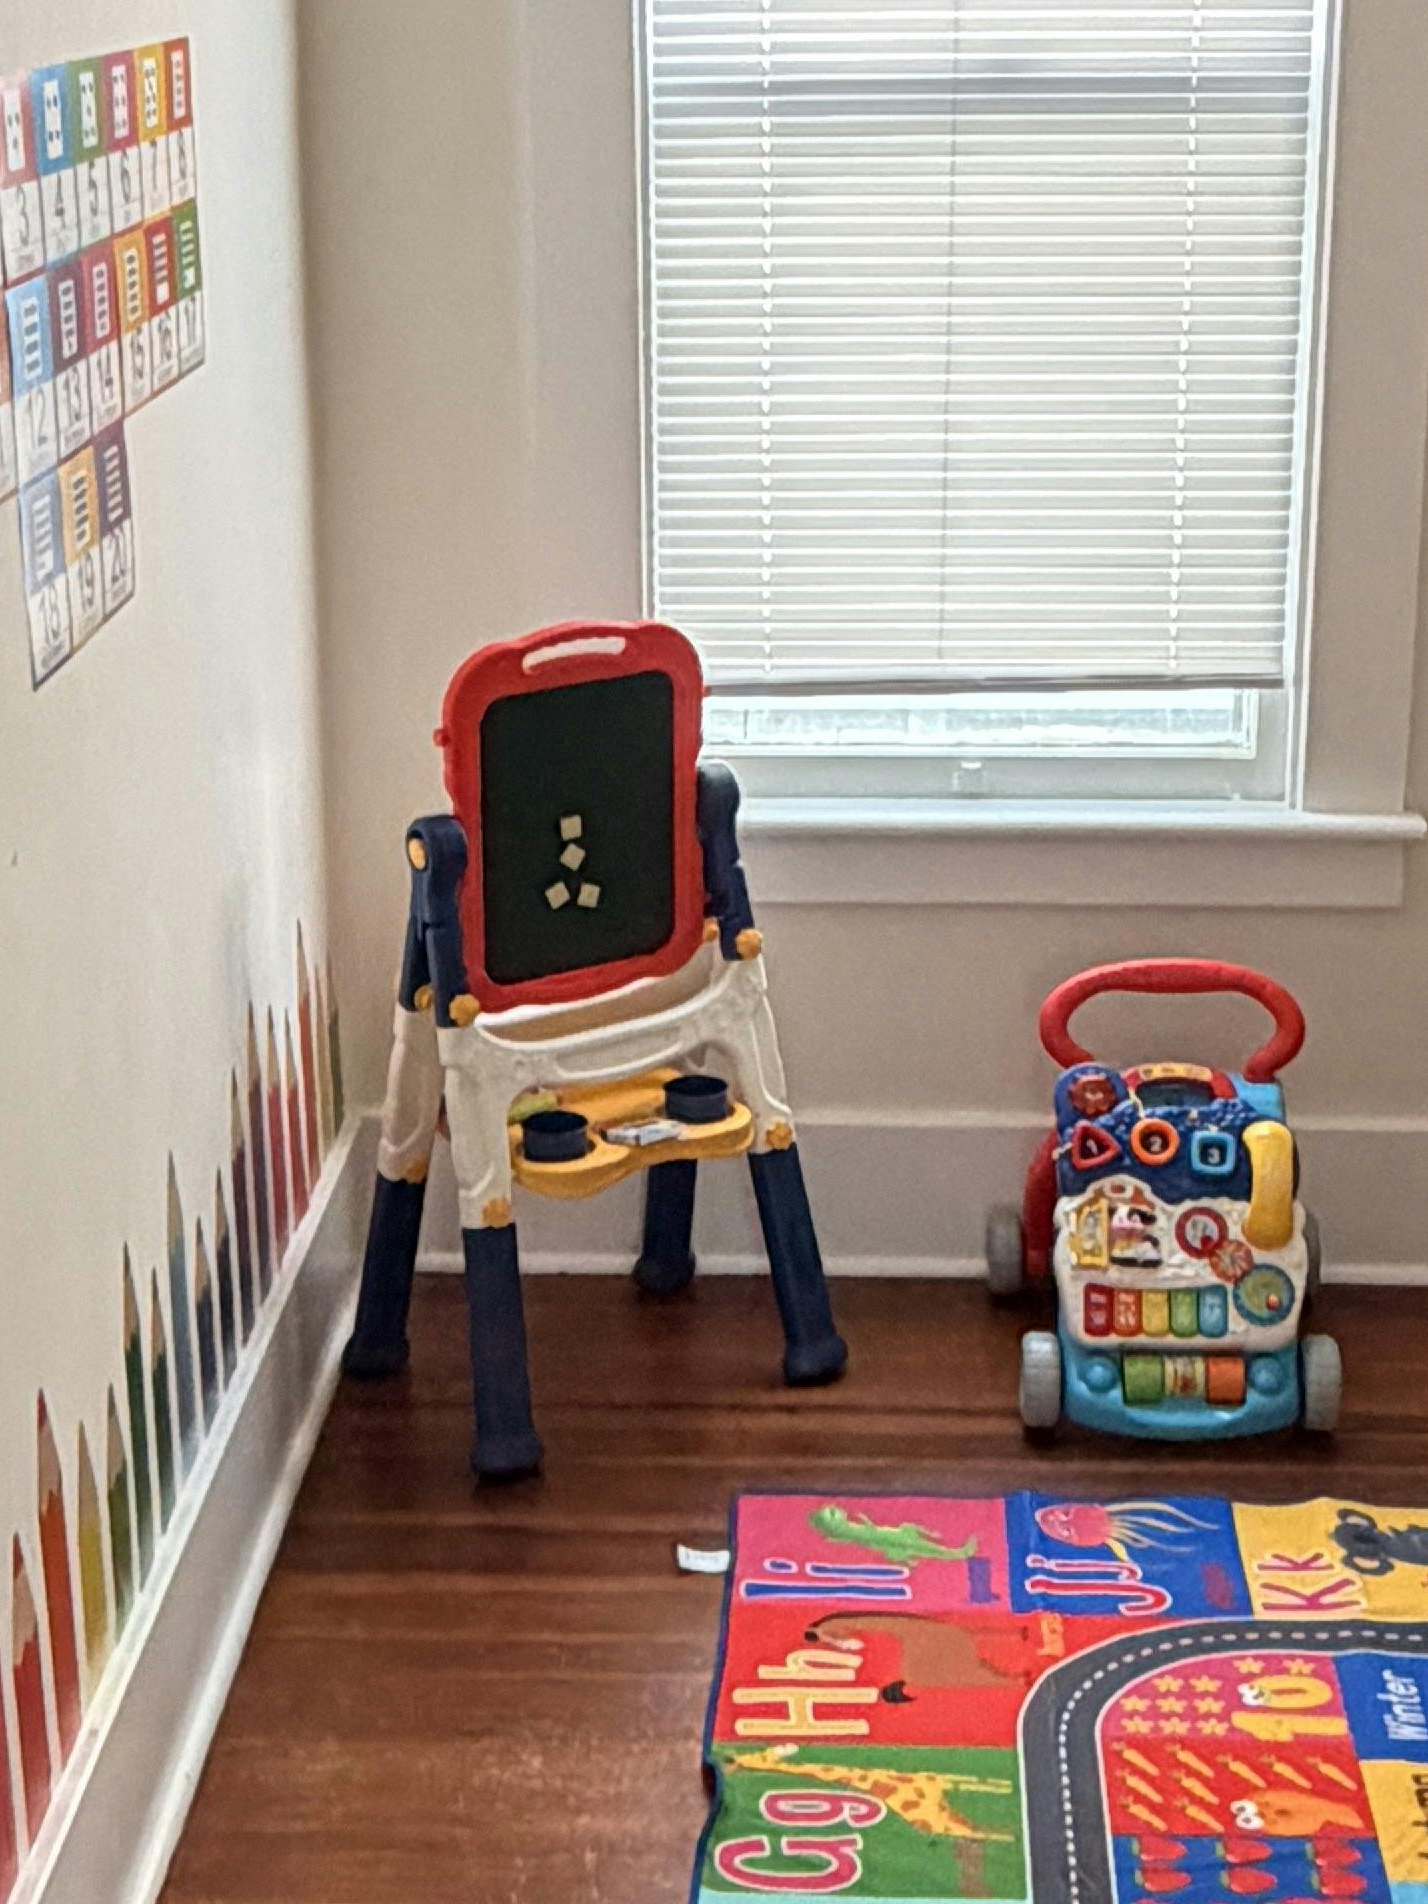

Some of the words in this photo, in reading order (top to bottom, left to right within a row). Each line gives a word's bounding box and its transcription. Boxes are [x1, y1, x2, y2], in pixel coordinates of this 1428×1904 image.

[17, 185, 31, 248] 3
[53, 175, 67, 230] 4
[87, 161, 100, 216] 5
[27, 387, 49, 450] 12
[63, 364, 82, 424] 13
[1087, 1137, 1099, 1154] 1
[1149, 1136, 1162, 1153] 2
[1207, 1147, 1221, 1165] 3
[1025, 1553, 1173, 1618] Jj
[1253, 1550, 1370, 1614] Kk
[731, 1648, 881, 1737] Hh
[713, 1787, 888, 1895] Gg
